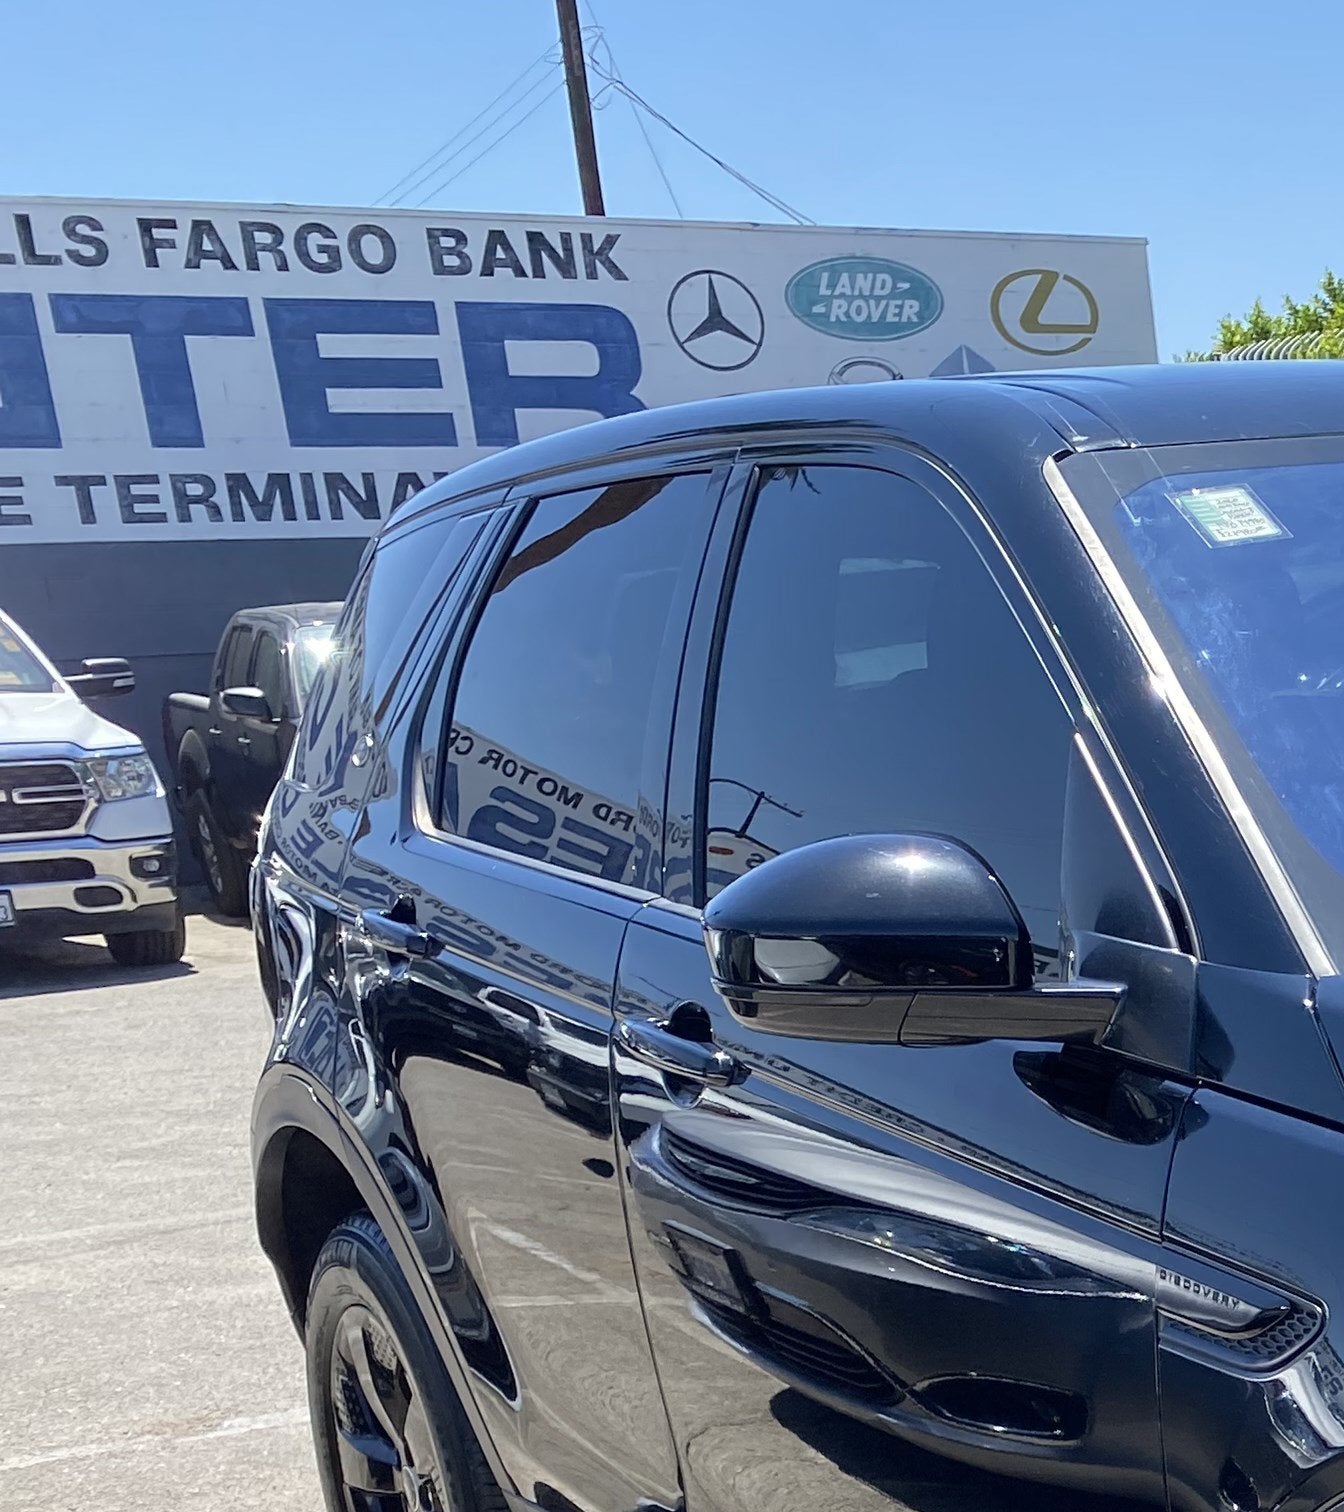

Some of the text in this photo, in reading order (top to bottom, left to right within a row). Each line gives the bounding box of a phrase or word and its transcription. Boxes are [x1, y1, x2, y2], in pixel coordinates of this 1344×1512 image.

[136, 217, 397, 276] FARGO
[425, 227, 629, 282] BANK
[819, 272, 893, 296] LAND
[829, 299, 920, 322] ROVER
[55, 471, 449, 527] TERMINA
[1160, 1268, 1239, 1310] DISCOVERY
